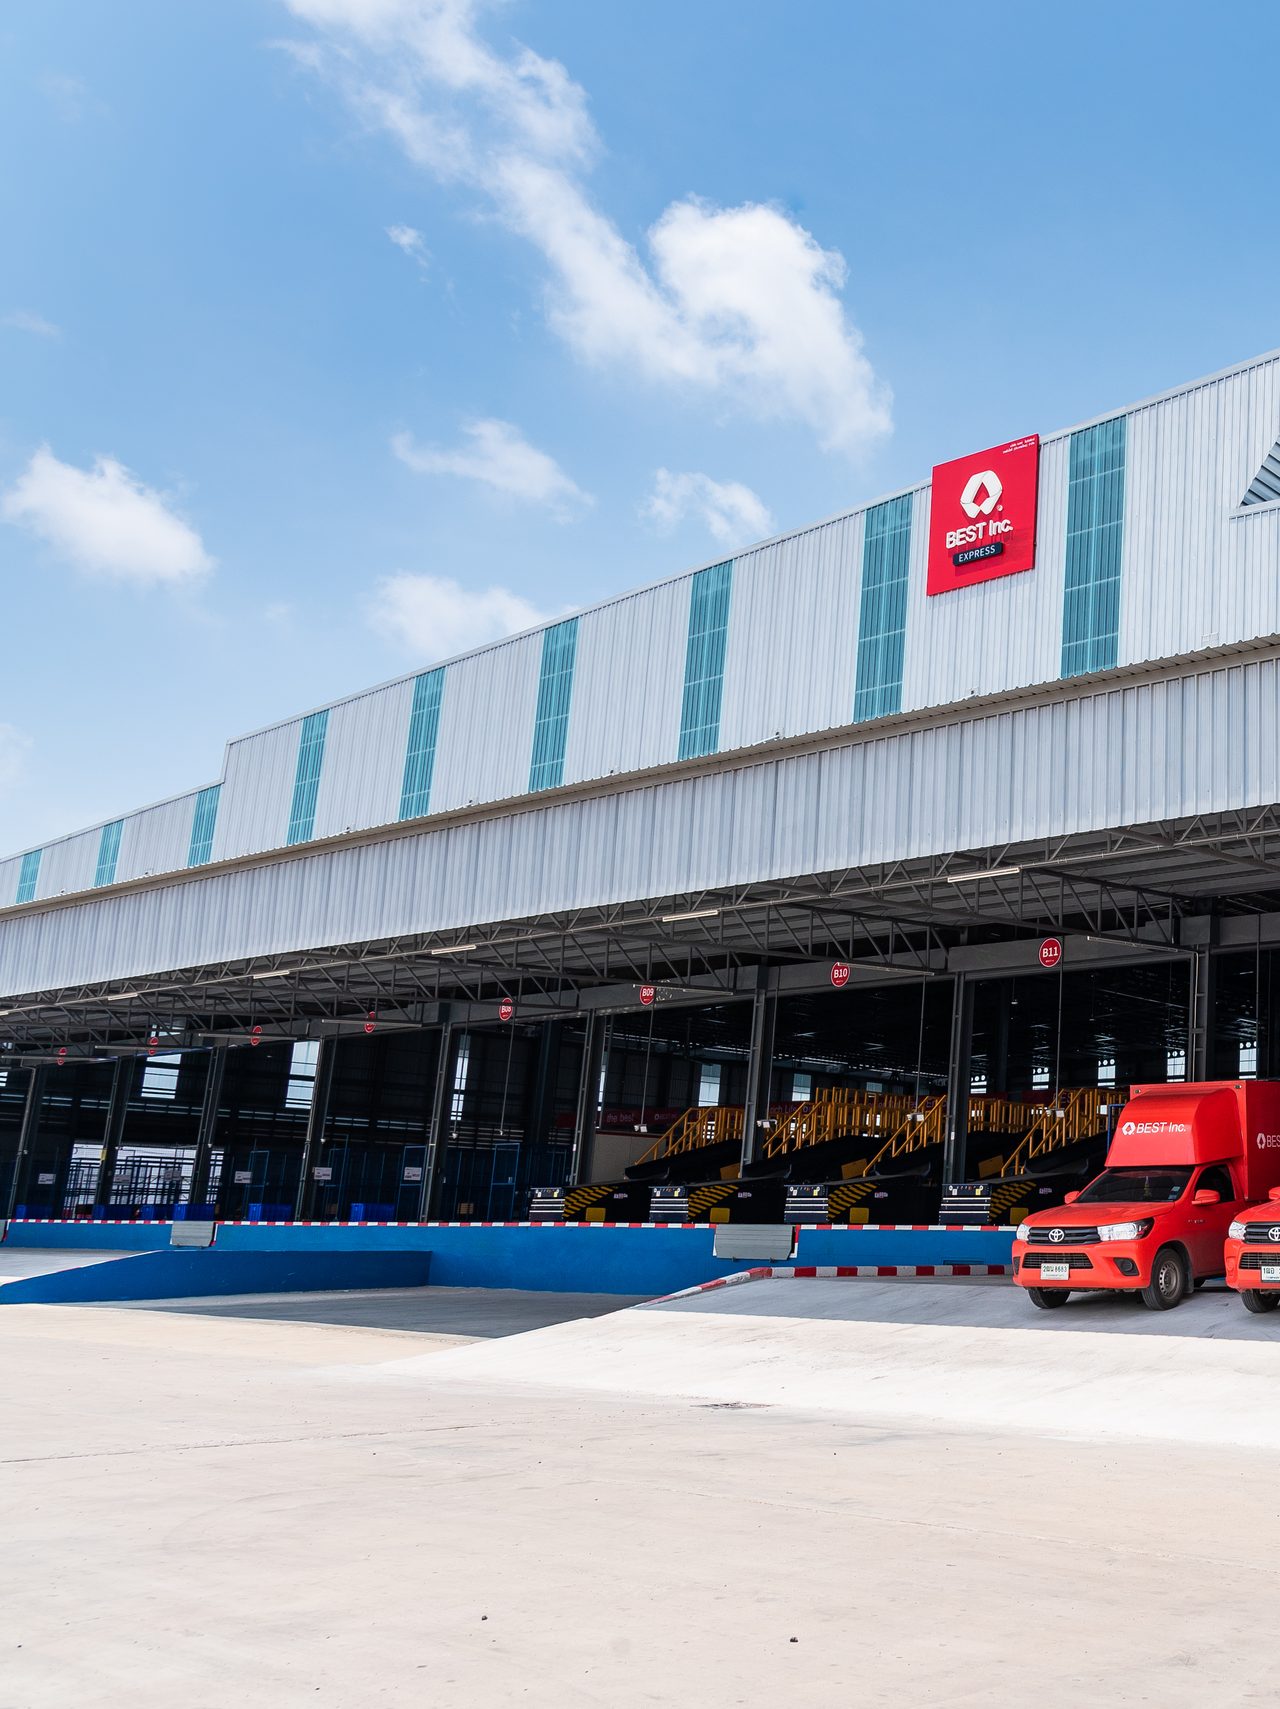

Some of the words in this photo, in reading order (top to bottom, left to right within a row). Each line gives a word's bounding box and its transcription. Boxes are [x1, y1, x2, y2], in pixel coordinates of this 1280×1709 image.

[946, 521, 987, 549] BEST
[988, 518, 1014, 536] Inc.
[958, 544, 996, 562] EXPRESS
[1042, 946, 1058, 958] B11
[834, 968, 847, 978] B10
[642, 988, 654, 996] B09
[1136, 1122, 1167, 1134] BEST
[1168, 1122, 1186, 1133] Inc.
